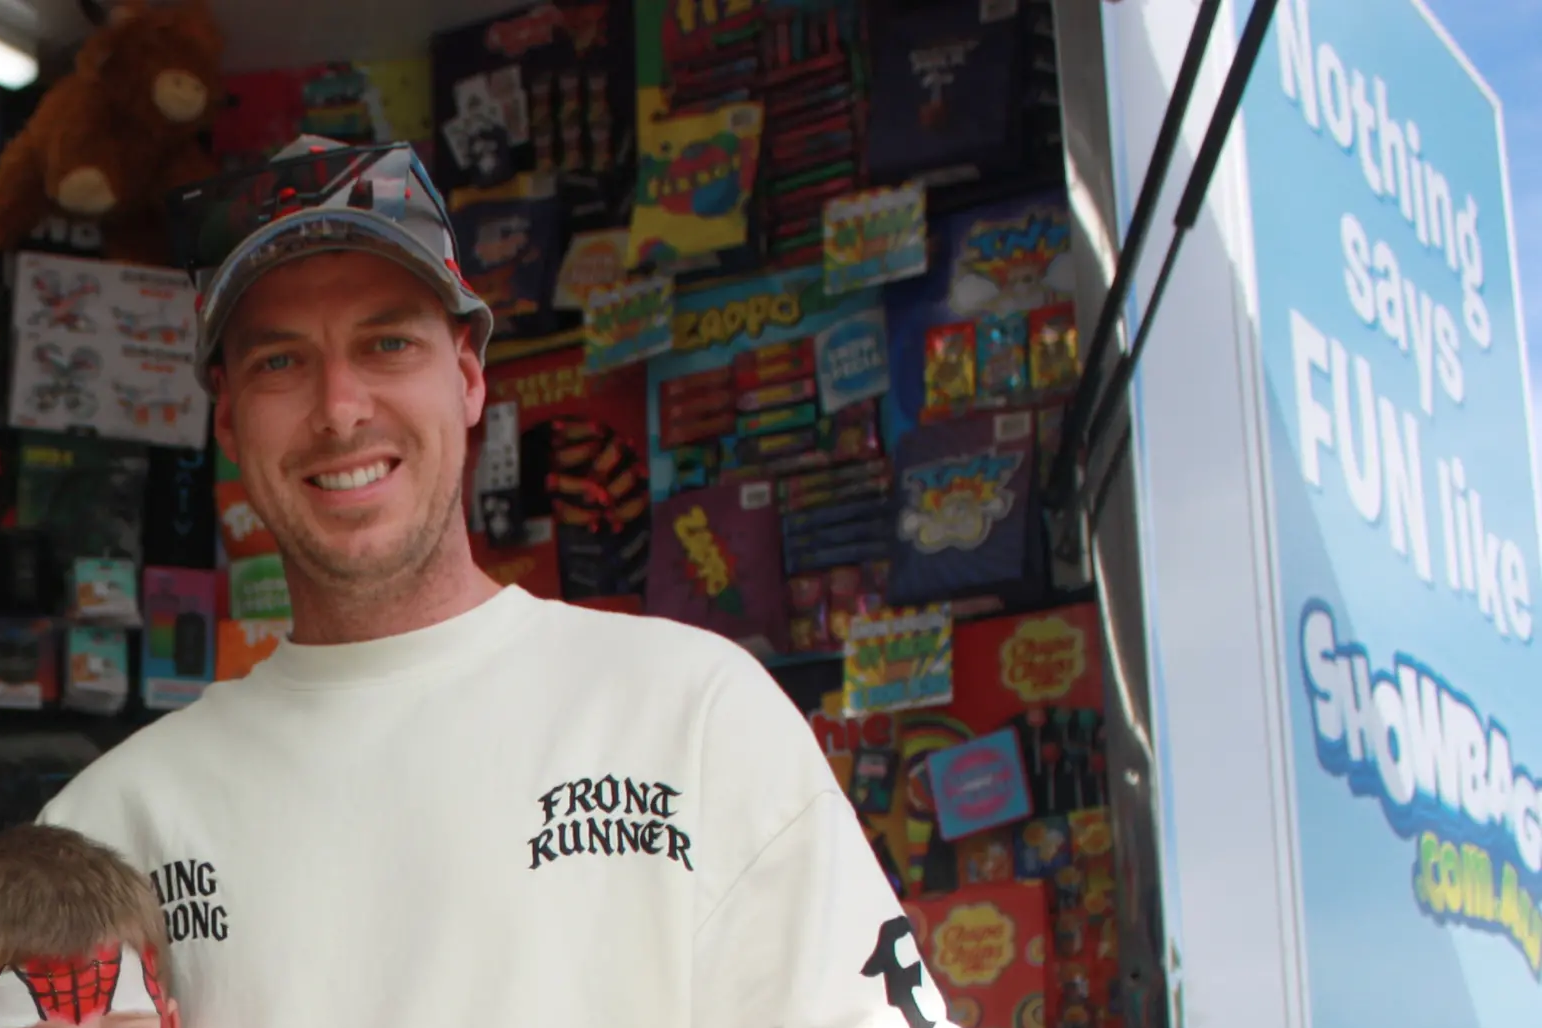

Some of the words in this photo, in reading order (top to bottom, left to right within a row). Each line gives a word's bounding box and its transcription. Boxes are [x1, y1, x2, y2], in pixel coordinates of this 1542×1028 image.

[1276, 0, 1490, 349] Nothing
[1340, 212, 1464, 416] says
[1289, 307, 1432, 585] FUN
[1438, 455, 1532, 642] like
[528, 814, 694, 872] RUNNER
[537, 774, 684, 822] FRONT
[1301, 606, 1542, 874] SHOWBAG
